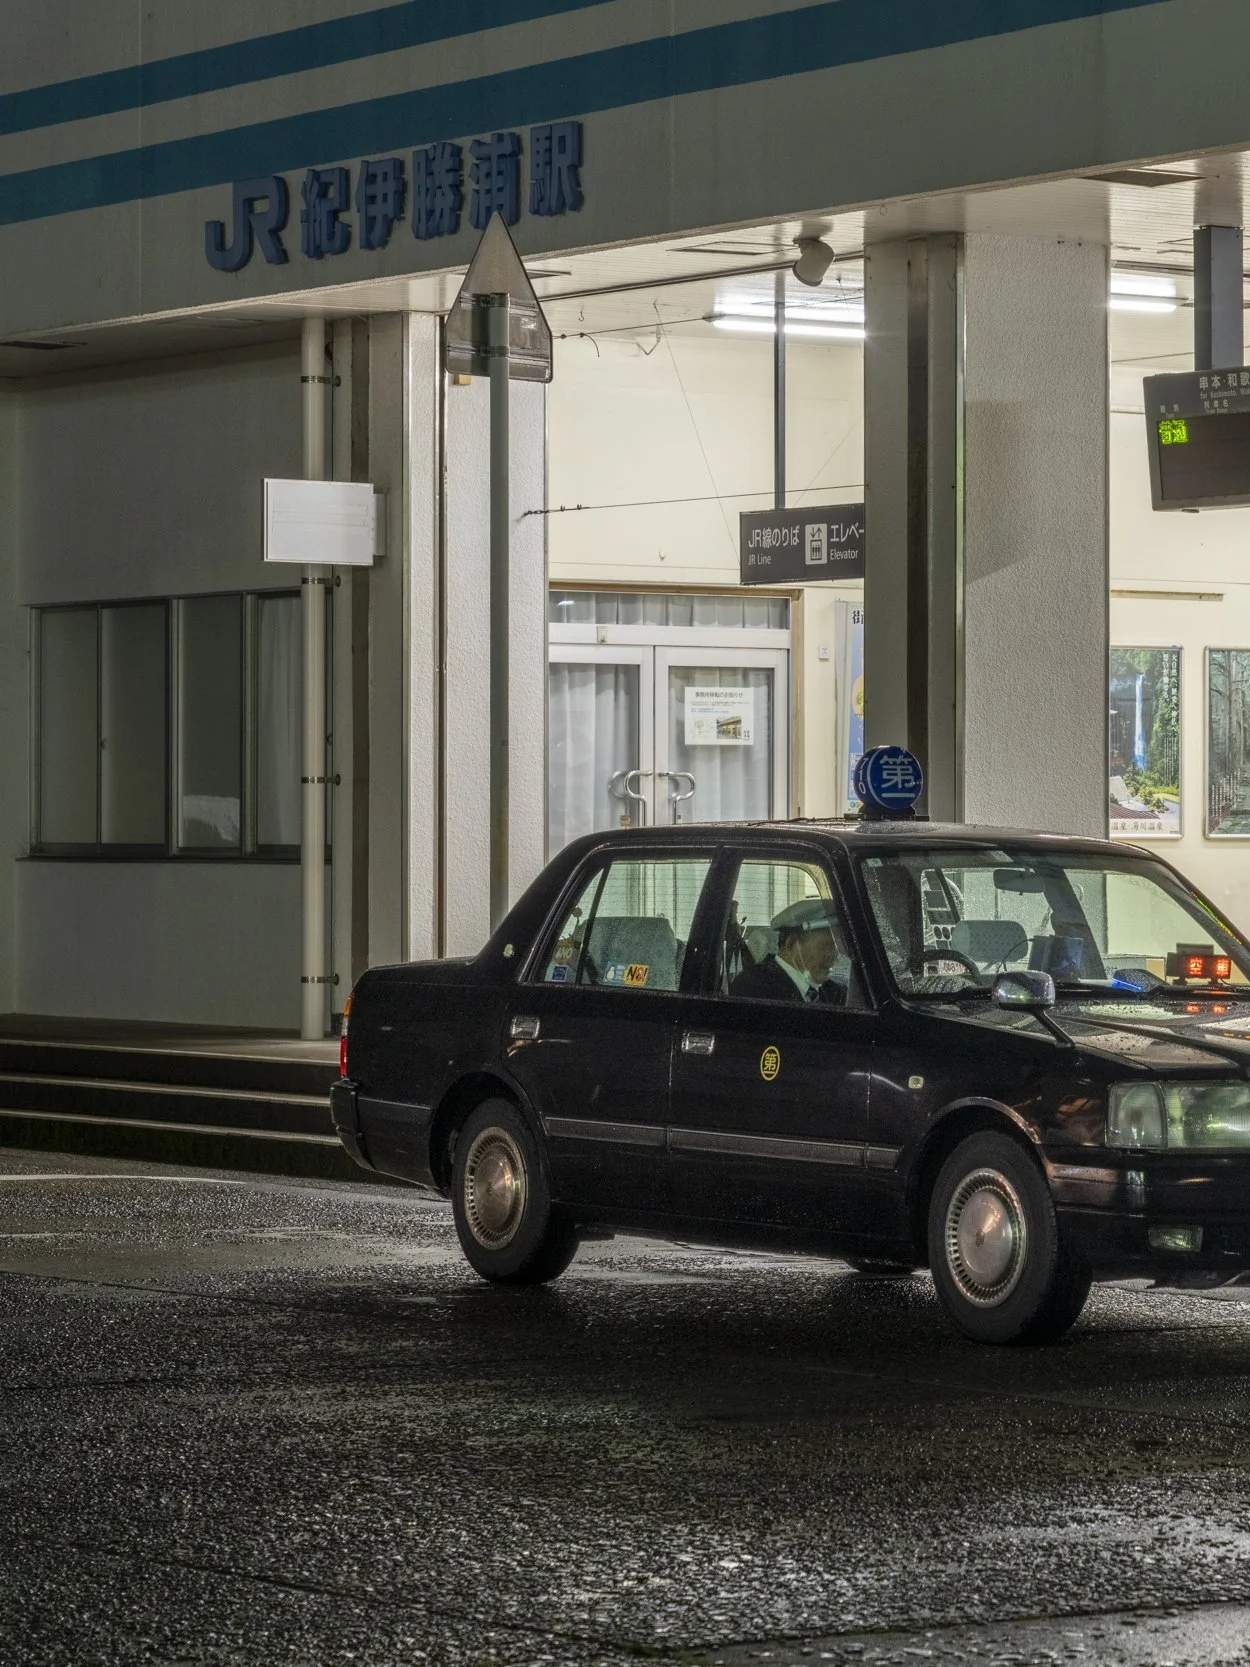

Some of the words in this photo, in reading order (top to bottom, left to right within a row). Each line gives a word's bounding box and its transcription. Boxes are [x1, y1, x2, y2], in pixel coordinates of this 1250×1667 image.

[748, 525, 800, 548] JR線のりば
[748, 555, 756, 566] JR
[757, 553, 772, 565] Line
[830, 548, 859, 560] Elevator
